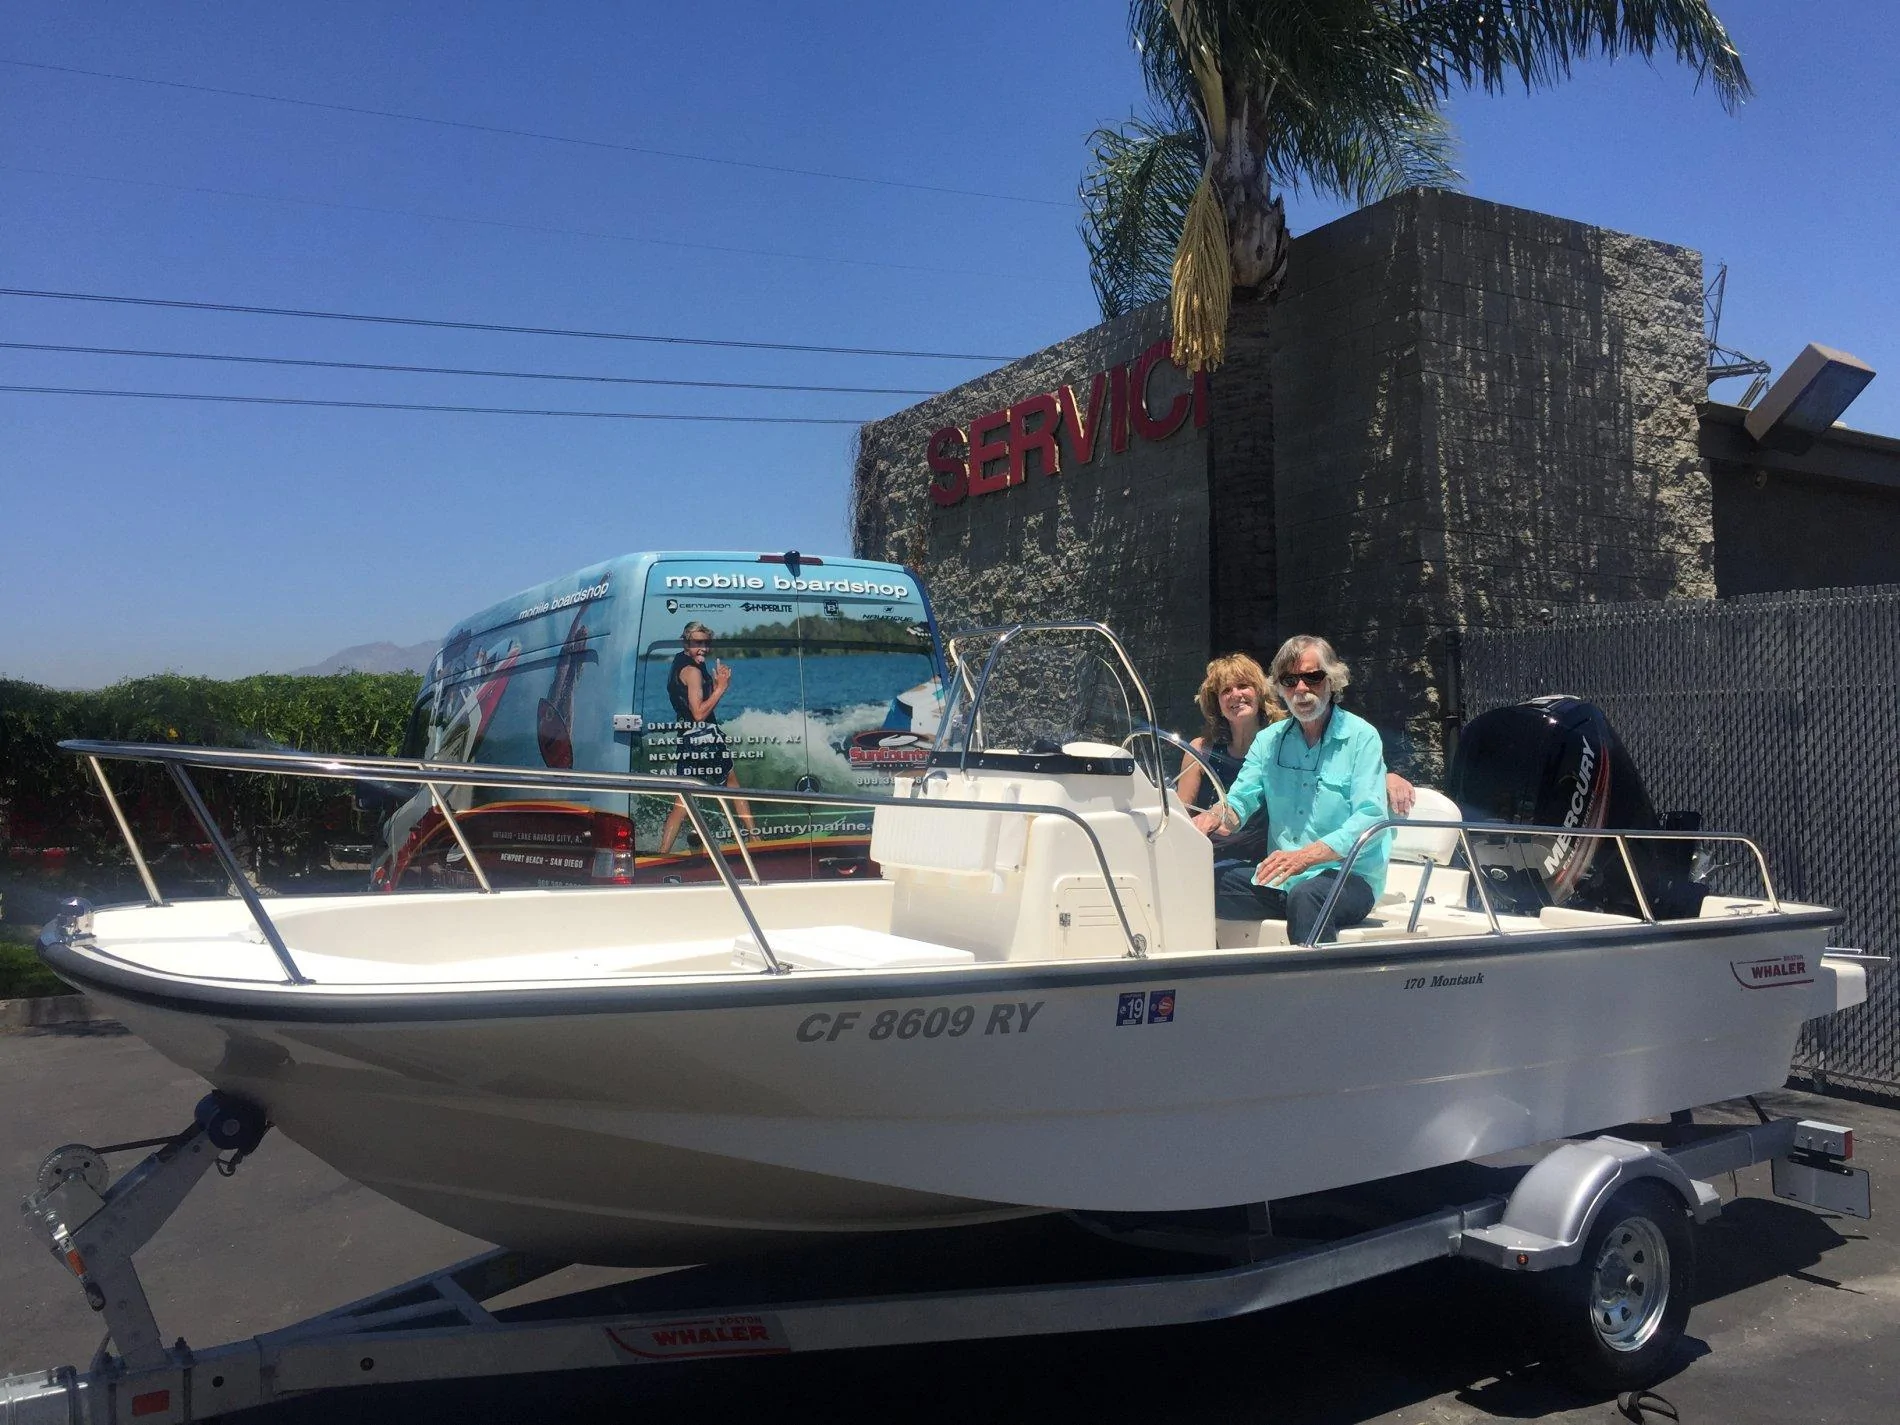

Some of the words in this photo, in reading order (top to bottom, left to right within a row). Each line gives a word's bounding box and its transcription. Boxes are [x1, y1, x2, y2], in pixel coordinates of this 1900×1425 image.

[665, 573, 764, 590] mobile
[773, 575, 909, 599] boardshop
[518, 599, 550, 620] mobile
[550, 582, 610, 611] boardshop
[750, 603, 793, 613] HYPERLITE
[647, 721, 706, 730] ONTARIO
[648, 737, 684, 746] LAKE
[690, 735, 742, 745] HAVASU
[785, 735, 802, 744] AZ
[649, 751, 717, 761] NEWPORT
[722, 750, 765, 759] BEACH
[684, 767, 723, 776] DIEGO
[1544, 735, 1596, 875] MERCURY
[550, 857, 563, 867] SAN
[563, 859, 584, 869] DIEGO
[1751, 962, 1806, 979] WHALER
[1403, 977, 1426, 990] 170
[1430, 972, 1485, 988] Montauk
[1127, 998, 1144, 1019] 19
[796, 1011, 862, 1043] CF
[868, 1005, 975, 1041] 8609
[984, 1001, 1046, 1035] RY
[652, 1325, 770, 1347] WHALER
